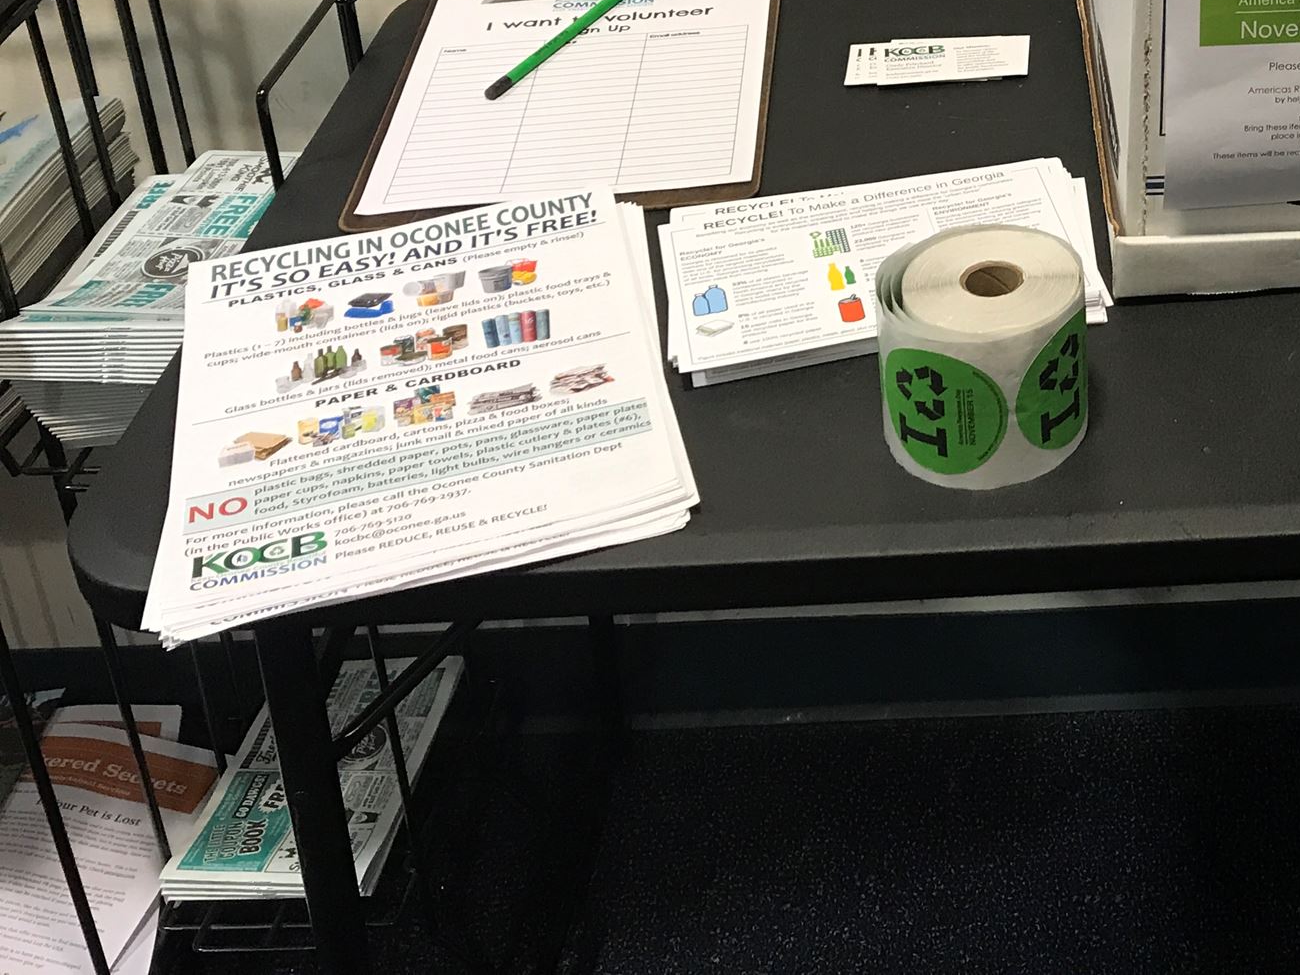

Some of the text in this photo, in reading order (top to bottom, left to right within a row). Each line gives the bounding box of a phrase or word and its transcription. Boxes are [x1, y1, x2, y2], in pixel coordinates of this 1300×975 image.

[486, 6, 714, 31] I want volunteer
[609, 24, 631, 33] Up
[204, 195, 259, 237] FREE
[703, 209, 782, 230] RECYCLE!
[809, 200, 846, 211] Make
[863, 185, 931, 202] Difference
[936, 179, 948, 187] in
[951, 171, 1005, 187] Georgia
[211, 240, 351, 282] RECYCLING
[358, 237, 383, 257] IN
[390, 213, 490, 248] OCONEE
[501, 192, 593, 226] COUNTY
[211, 209, 596, 299] IT'S SO EASY! AND IT'S FREE!
[228, 257, 457, 308] PLASTICS, GLASS & CANS
[315, 388, 377, 407] PAPER
[405, 359, 520, 391] CARDBOARD
[188, 497, 248, 523] NO
[190, 555, 328, 592] COMMISSION
[192, 530, 328, 577] KOCB
